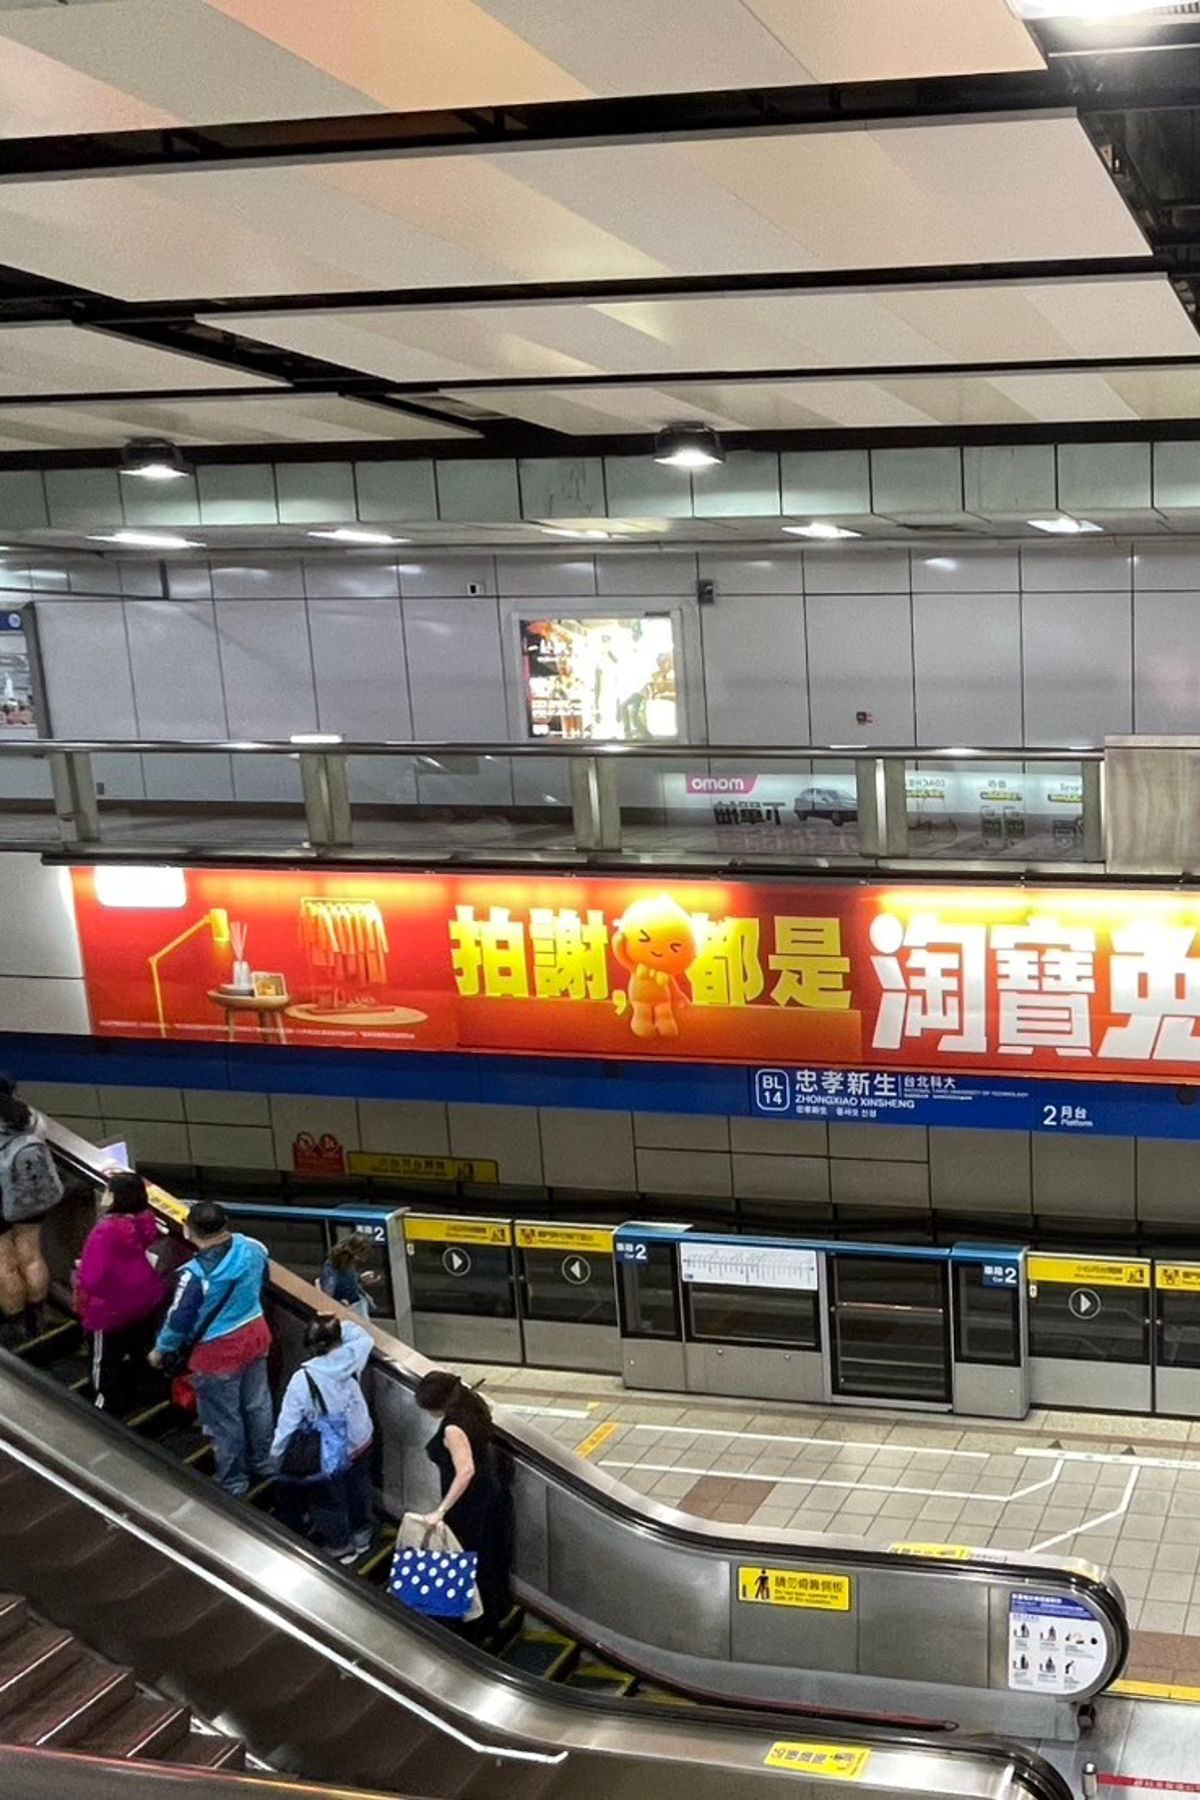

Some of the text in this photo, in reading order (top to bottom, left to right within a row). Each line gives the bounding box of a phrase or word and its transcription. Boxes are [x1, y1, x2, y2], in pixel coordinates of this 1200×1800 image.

[762, 1075, 784, 1090] BL
[795, 1069, 898, 1098] 忠孝新生
[903, 1075, 956, 1090] 台北科大
[764, 1091, 782, 1105] 14
[795, 1094, 859, 1107] ZHONGXIAO
[860, 1097, 915, 1109] XINSHENG
[1042, 1105, 1057, 1126] 2
[1060, 1106, 1087, 1119] 月台
[374, 1226, 386, 1242] 2
[635, 1243, 648, 1260] 2
[1004, 1266, 1017, 1284] 2
